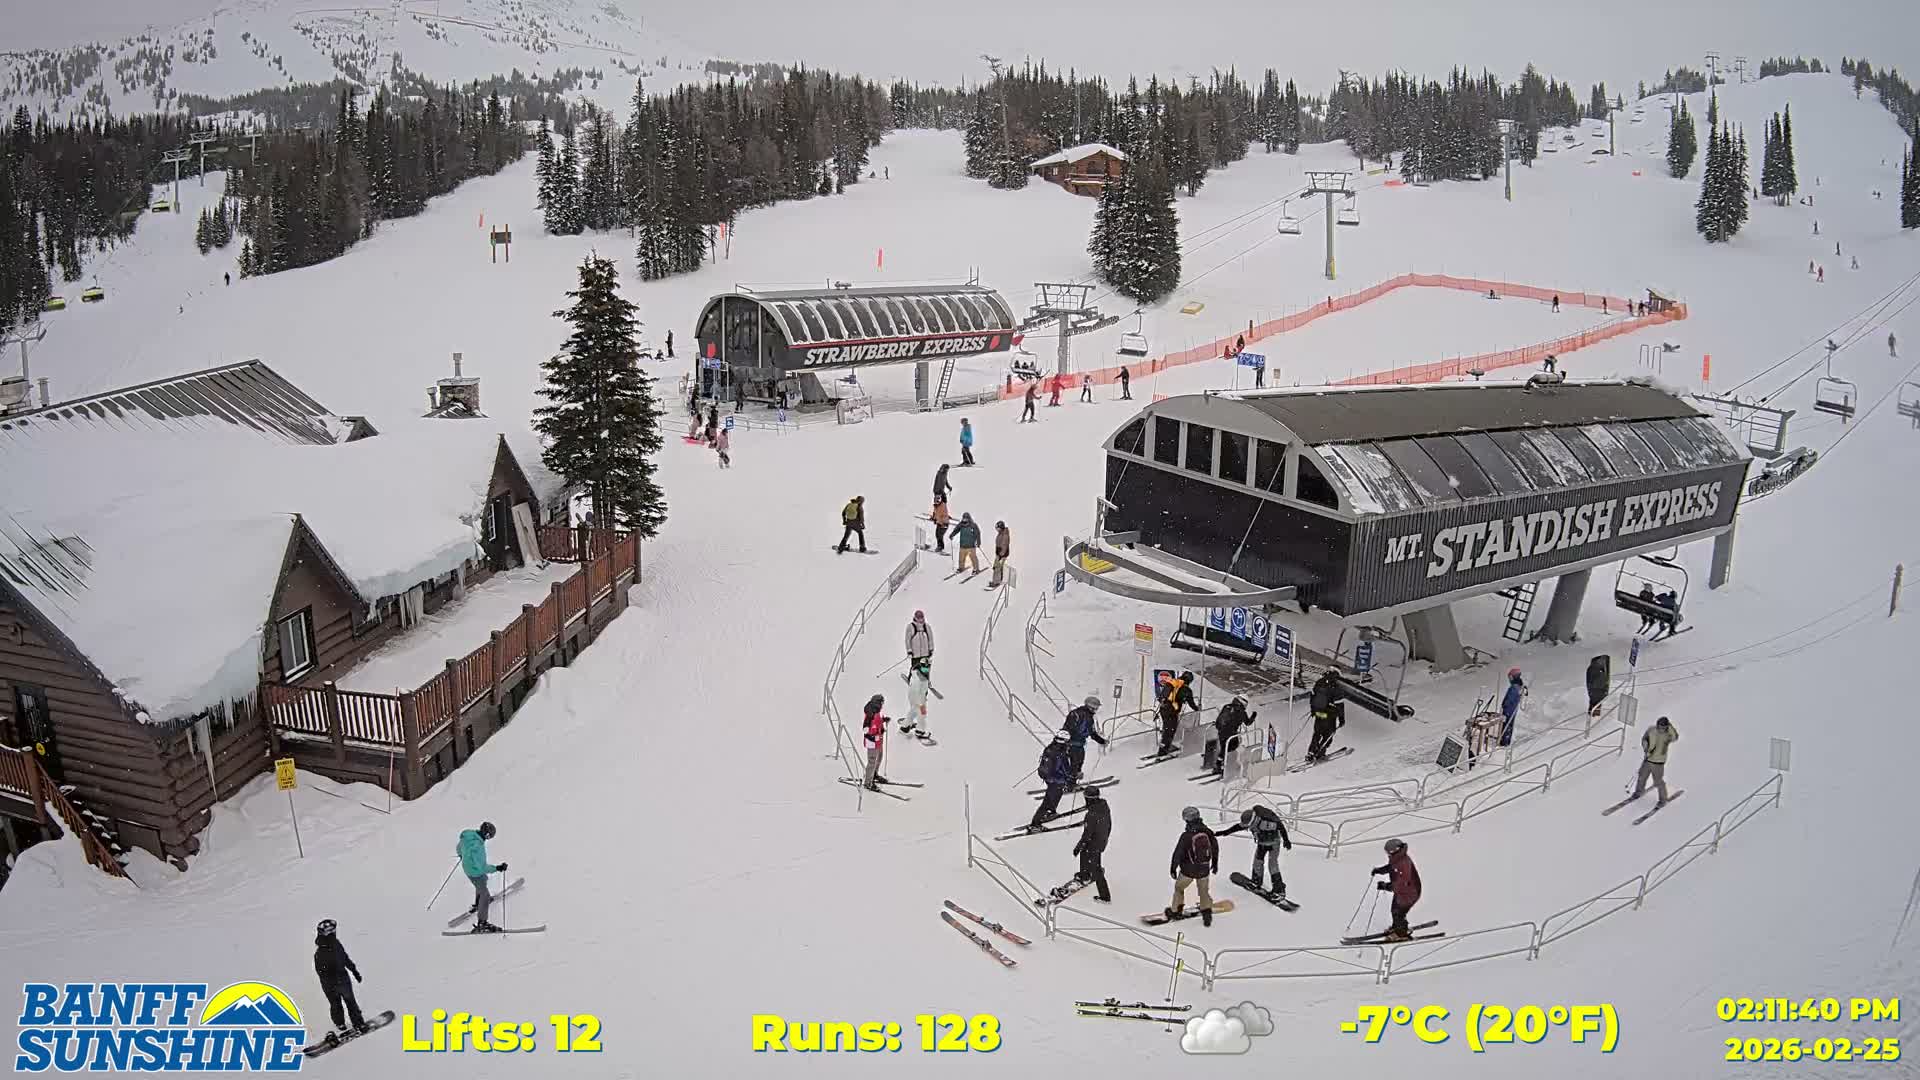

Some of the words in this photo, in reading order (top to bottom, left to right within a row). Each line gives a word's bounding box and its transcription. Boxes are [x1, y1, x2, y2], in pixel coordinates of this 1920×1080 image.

[803, 341, 920, 366] STRAWBERRY
[921, 336, 988, 355] EXPRESS
[1384, 533, 1425, 564] MT.
[1427, 499, 1617, 579] STANDISH
[1618, 481, 1722, 537] EXPRESS
